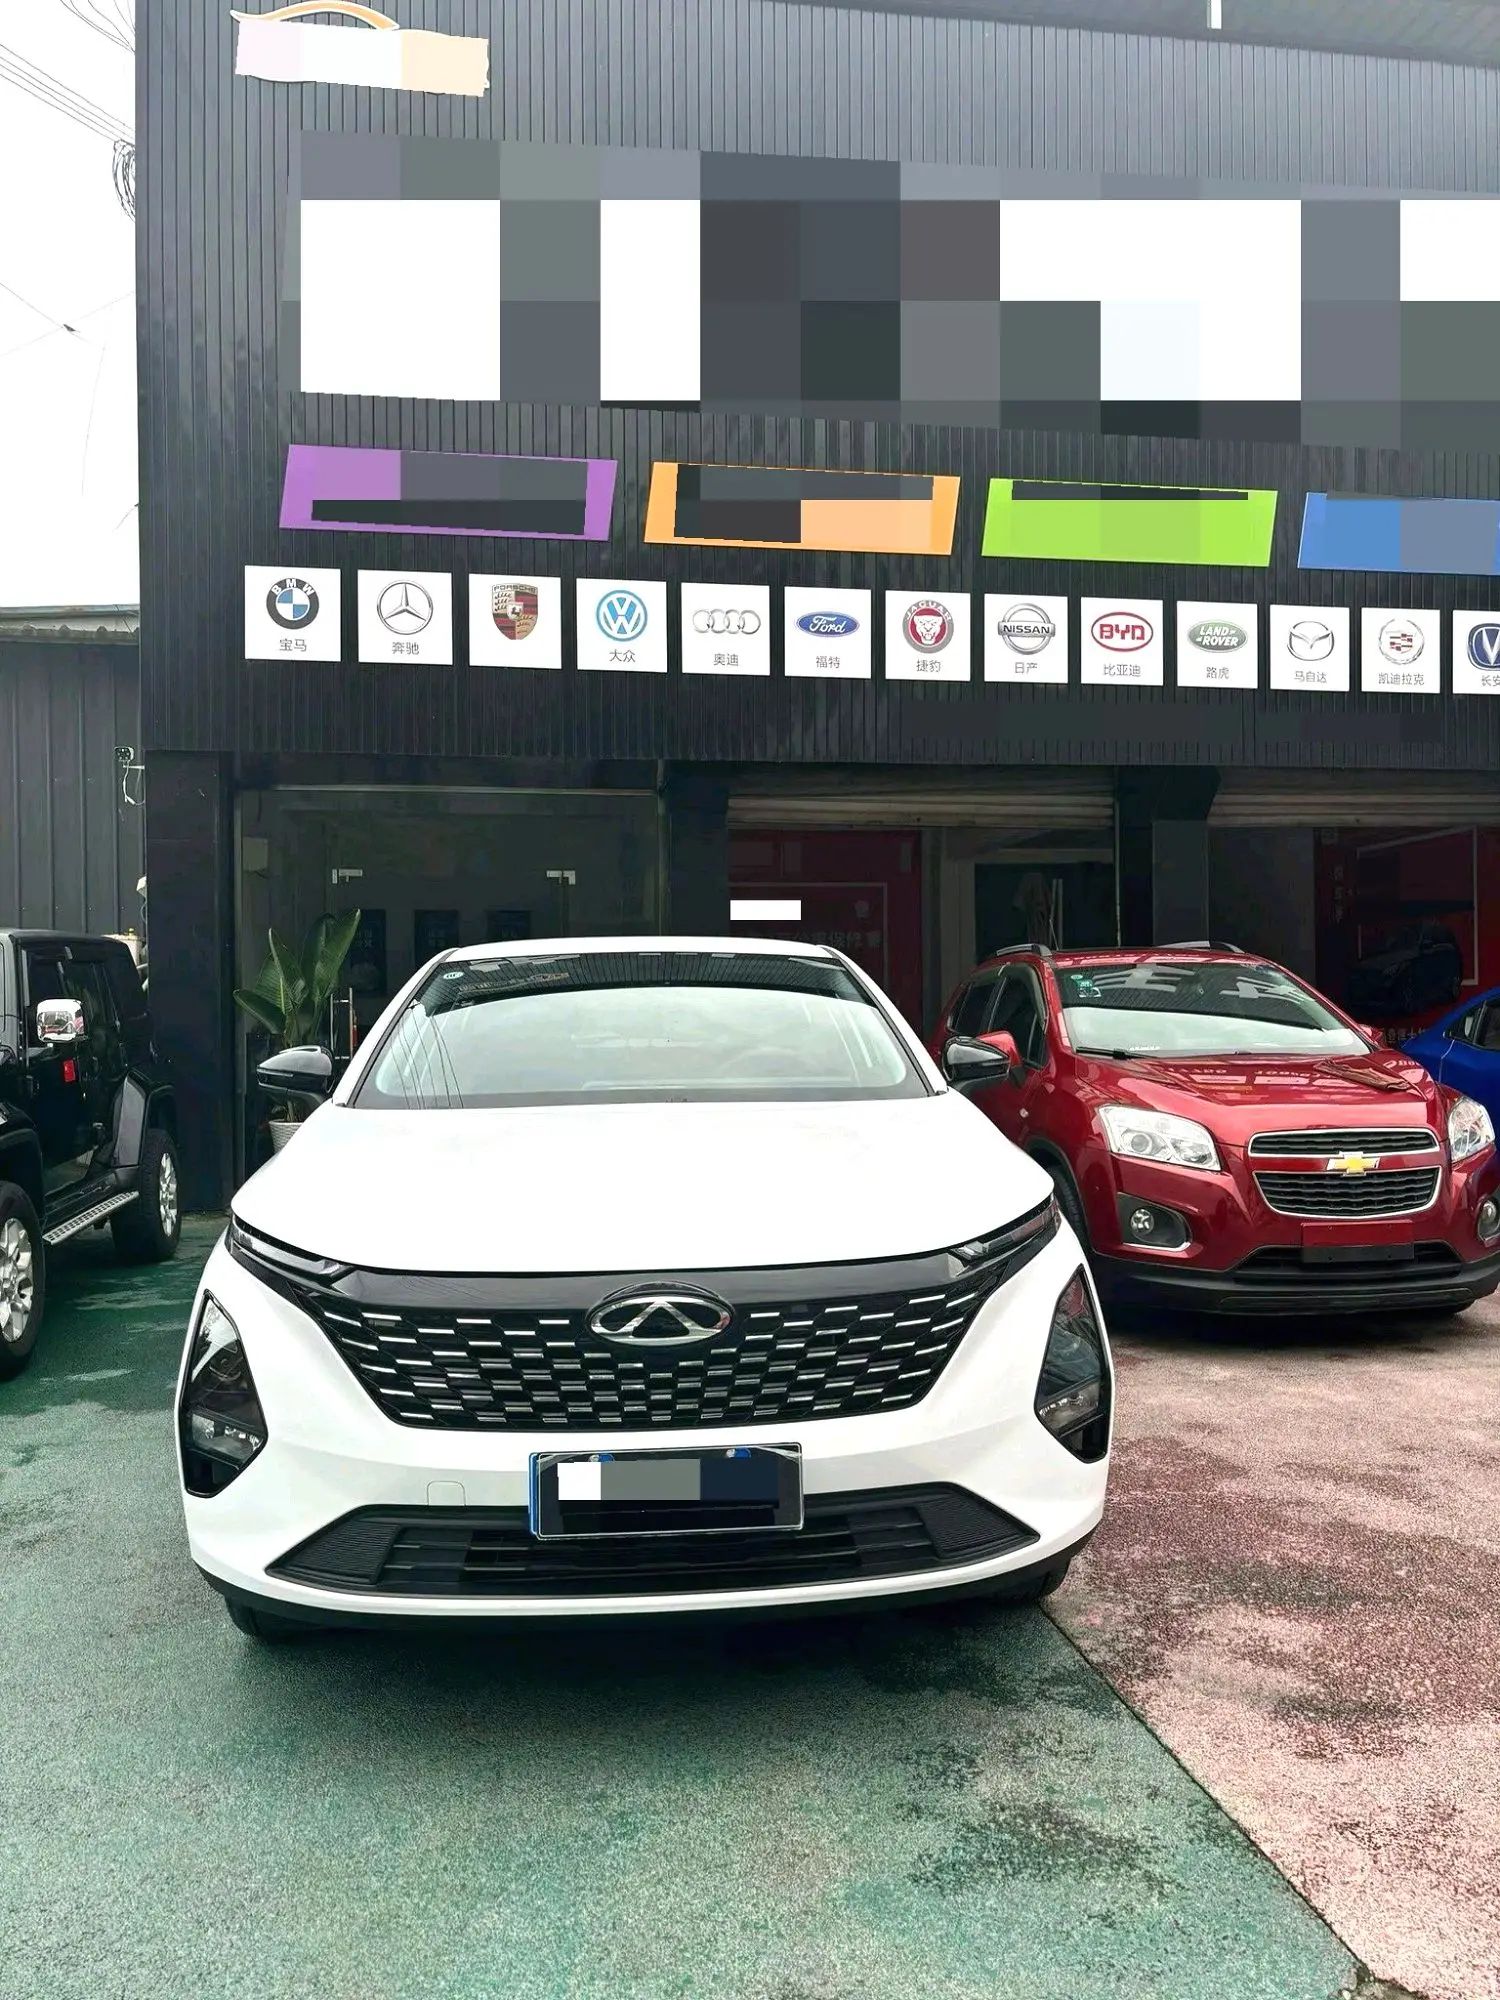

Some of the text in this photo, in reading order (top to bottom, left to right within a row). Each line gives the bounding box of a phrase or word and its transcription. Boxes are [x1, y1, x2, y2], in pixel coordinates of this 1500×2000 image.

[271, 578, 315, 595] BMW
[493, 584, 536, 592] PORSCHE
[905, 600, 952, 621] JAGUAR
[809, 615, 847, 634] Ford
[1003, 624, 1050, 634] NISSAN
[1200, 625, 1230, 637] LAND
[1099, 623, 1145, 641] BYD
[279, 638, 307, 652] 宝马
[392, 641, 420, 655] 奔驰
[1201, 636, 1239, 647] ROVER
[609, 649, 636, 663] 大众
[713, 652, 739, 667] 奥迪
[815, 655, 841, 669] 福特
[916, 659, 941, 673] 捷豹
[1014, 661, 1038, 675] 日产
[1103, 663, 1141, 678] 比亚迪
[1206, 667, 1231, 680] 路虎
[1294, 670, 1327, 684] 马自达
[1378, 672, 1425, 686] 凯迪拉克
